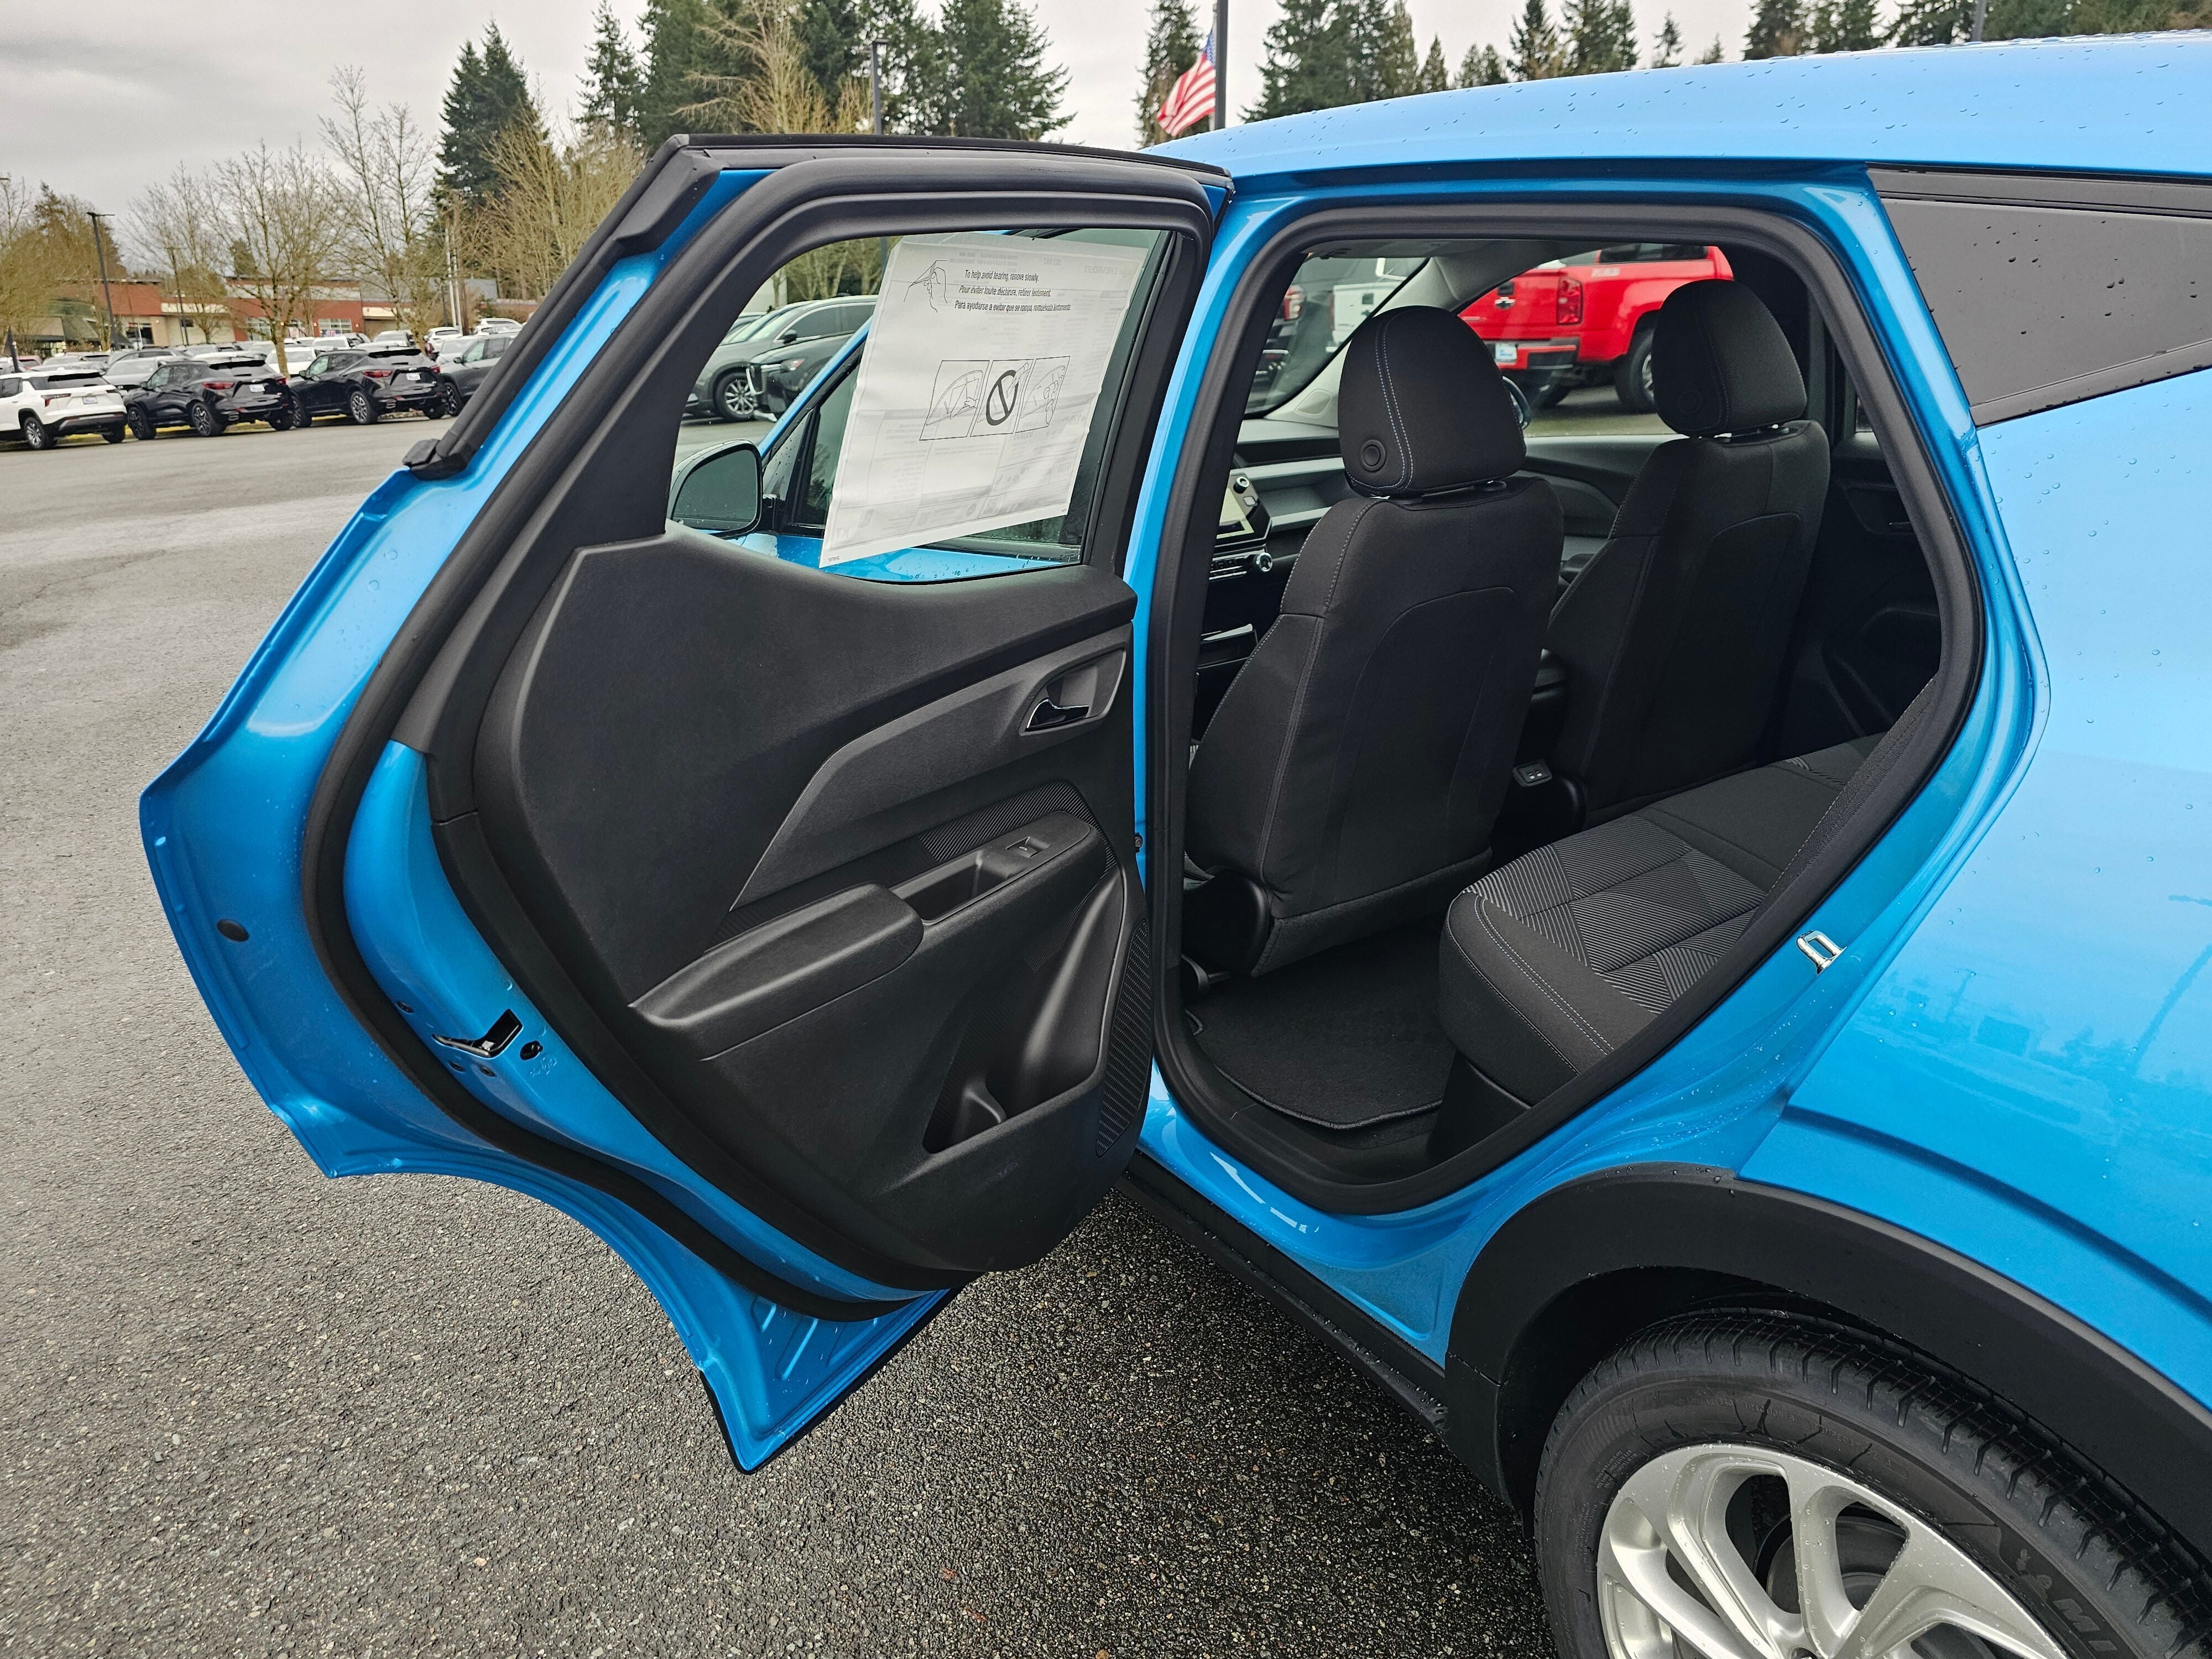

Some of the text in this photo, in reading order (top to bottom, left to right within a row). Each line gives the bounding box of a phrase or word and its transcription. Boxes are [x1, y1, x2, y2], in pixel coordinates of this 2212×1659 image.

[964, 270, 971, 278] To
[971, 270, 981, 280] help
[981, 271, 994, 279] avoid
[1025, 273, 1040, 283] slowly.
[959, 285, 971, 294] Pour
[971, 285, 983, 294] éviter
[984, 286, 997, 295] toute
[1018, 288, 1031, 296] retirer
[954, 300, 966, 309] Para
[967, 301, 988, 312] ayudarse
[993, 302, 1005, 311] evitar
[1006, 304, 1014, 313] que
